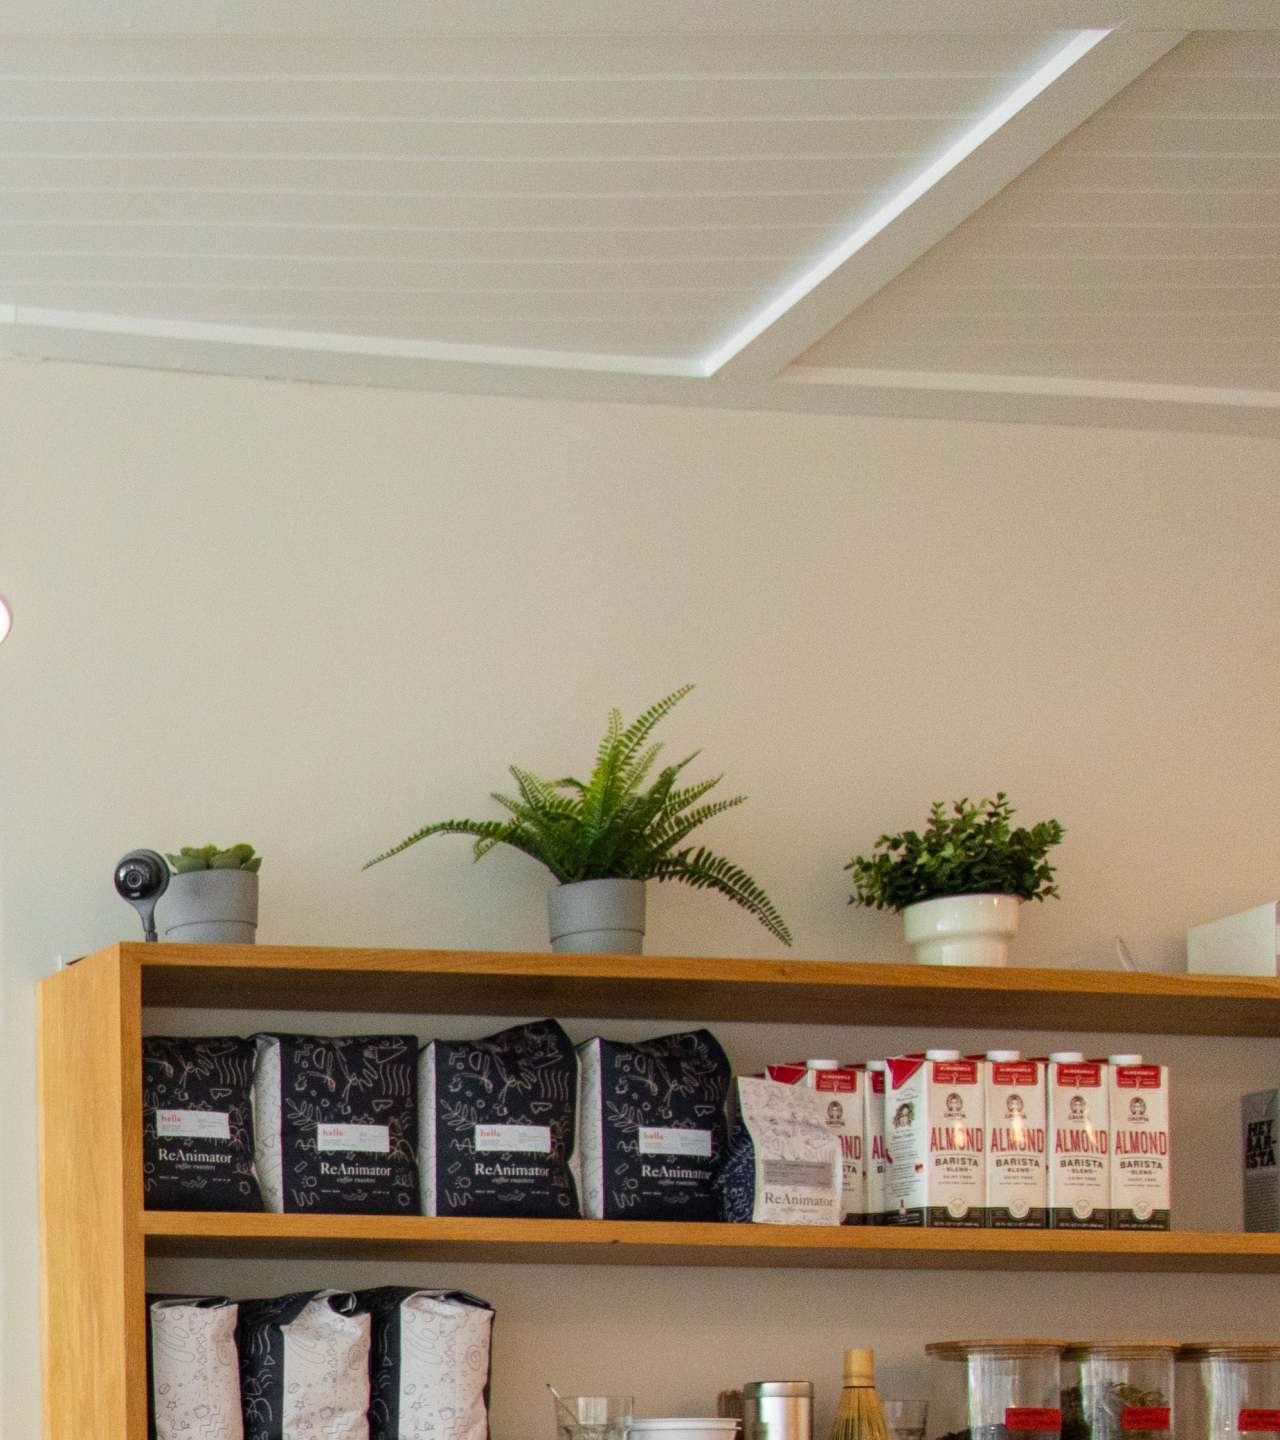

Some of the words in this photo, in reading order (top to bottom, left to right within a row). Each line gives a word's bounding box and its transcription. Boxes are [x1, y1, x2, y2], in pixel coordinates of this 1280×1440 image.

[1247, 1120, 1272, 1137] HEY
[930, 1126, 984, 1153] ALMOND
[990, 1127, 1045, 1154] ALMOND
[1054, 1128, 1108, 1154] ALMOND
[1114, 1129, 1168, 1156] ALMOND
[158, 1148, 233, 1164] ReAnimator
[935, 1156, 980, 1167] BARISTA
[995, 1157, 1040, 1168] BARISTA
[1060, 1158, 1104, 1169] BARISTA
[320, 1161, 393, 1177] ReAnimator
[474, 1162, 551, 1177] ReAnimator
[641, 1164, 713, 1180] ReAnimator
[1119, 1159, 1163, 1170] BARISTA
[764, 1191, 834, 1208] ReAnimator
